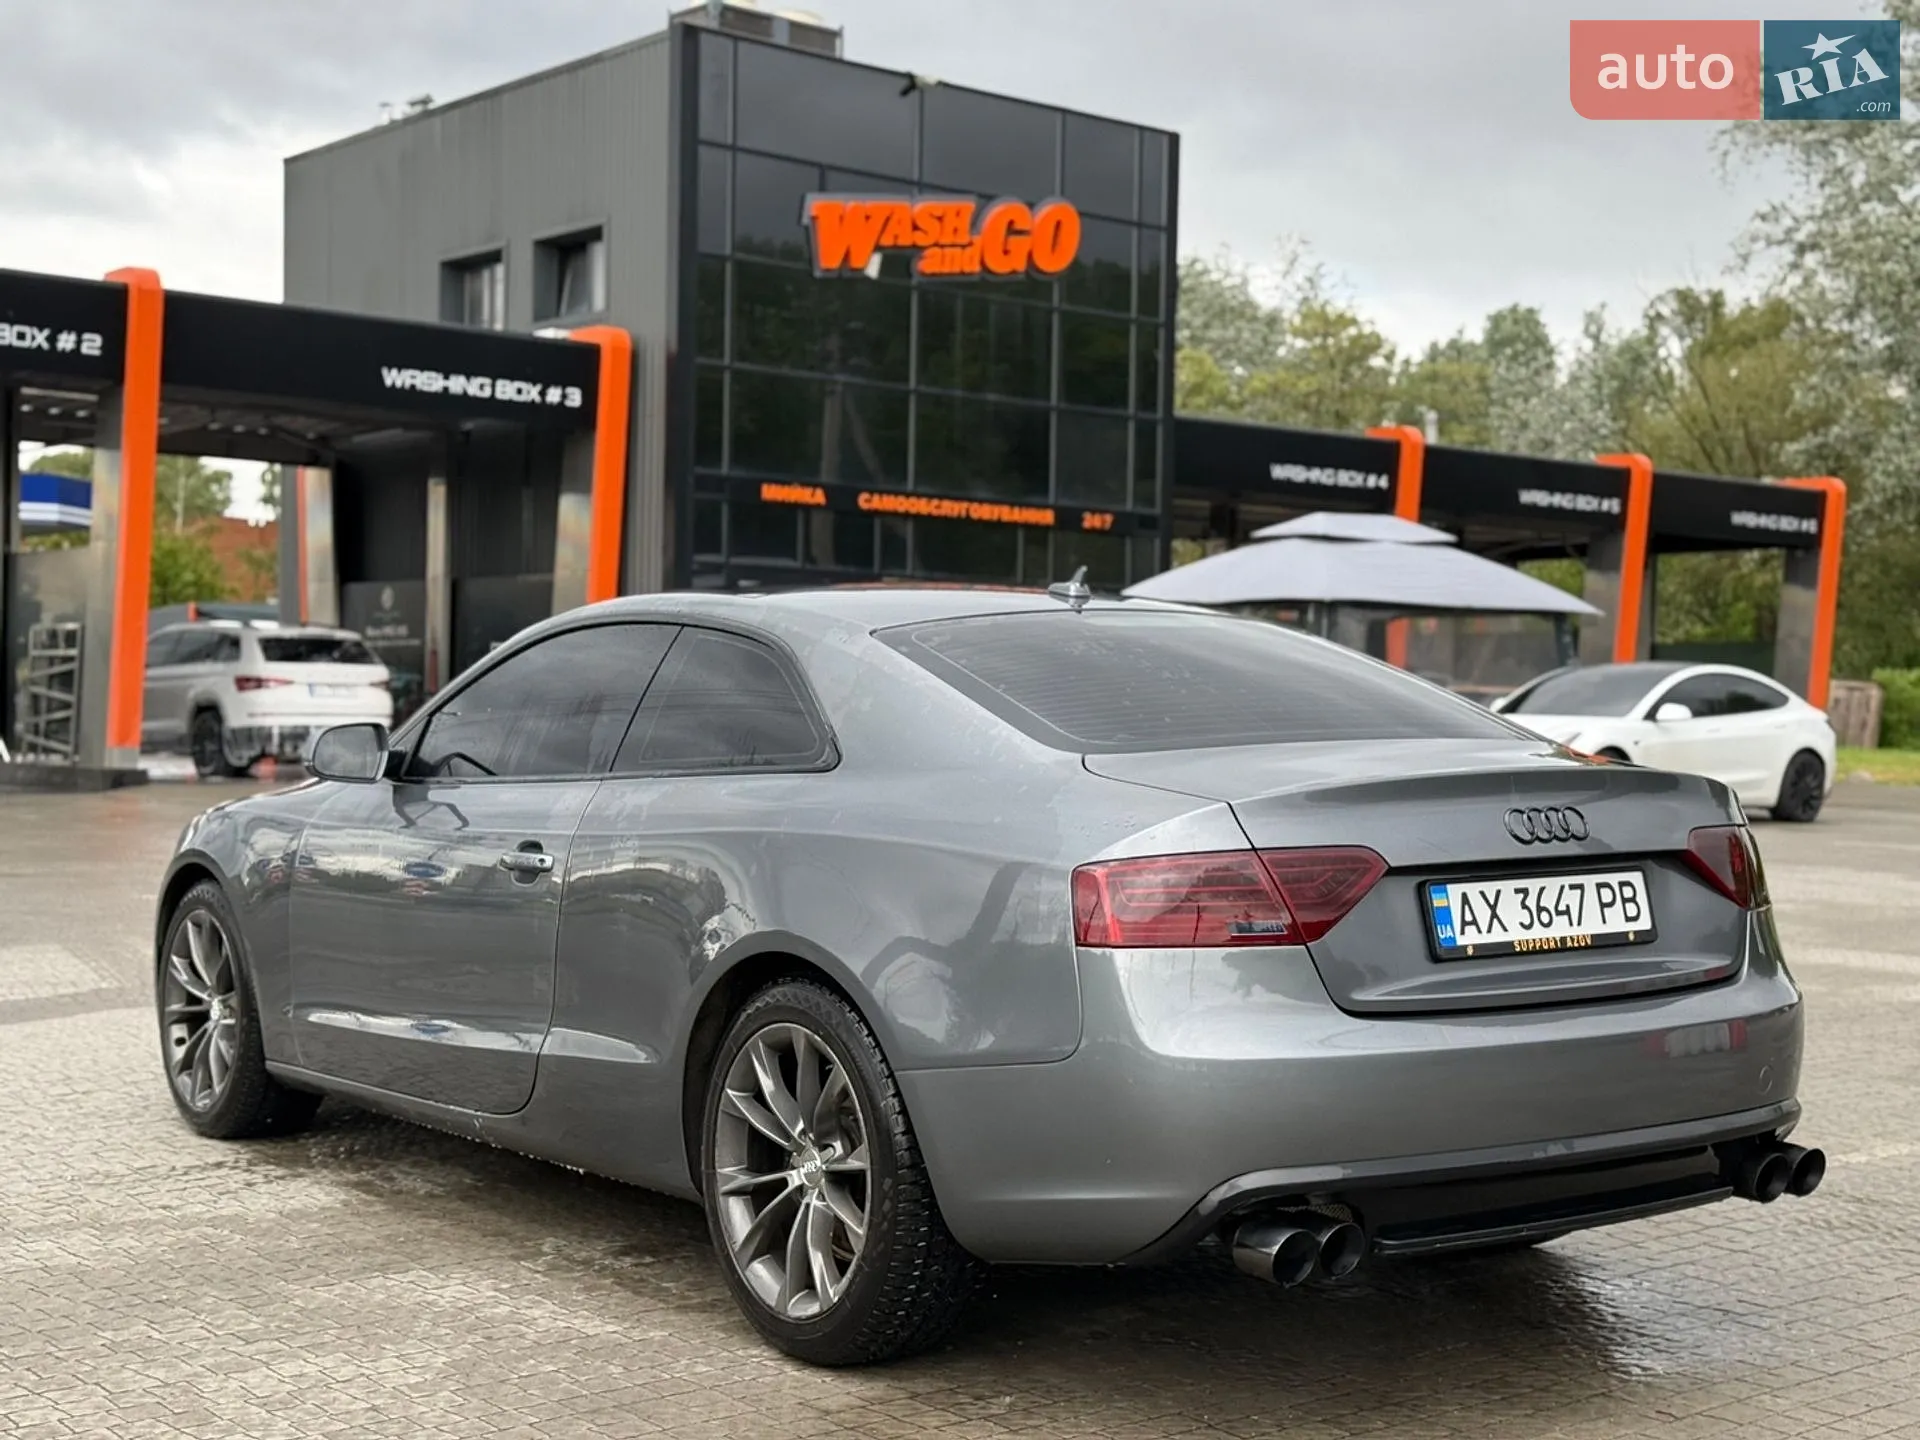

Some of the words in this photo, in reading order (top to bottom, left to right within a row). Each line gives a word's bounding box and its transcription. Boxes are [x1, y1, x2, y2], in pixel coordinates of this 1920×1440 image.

[980, 200, 1081, 275] GO
[381, 366, 493, 399] WASHING
[494, 378, 543, 404] BOX
[1459, 888, 1509, 937] AX
[1513, 883, 1586, 931] 3647
[1595, 880, 1642, 926] PB
[1437, 925, 1455, 939] UA
[1513, 938, 1563, 952] SUPPORT
